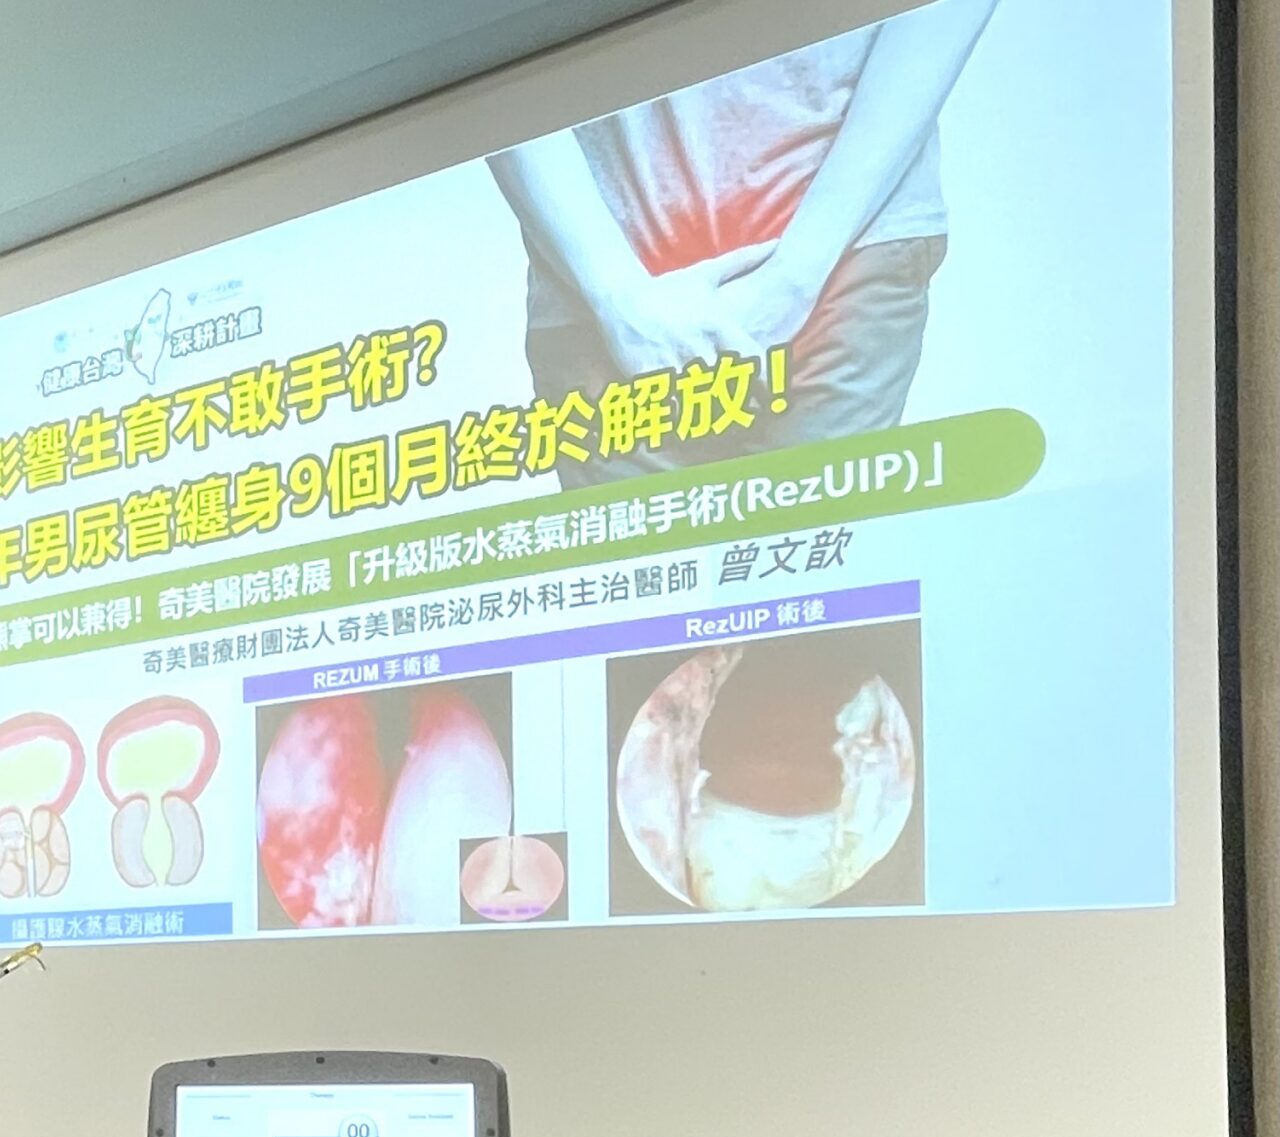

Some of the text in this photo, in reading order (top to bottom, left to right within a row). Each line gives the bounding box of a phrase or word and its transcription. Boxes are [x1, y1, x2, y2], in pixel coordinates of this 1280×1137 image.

[685, 600, 827, 639] RezUIP 術後
[312, 653, 442, 690] REZUM 手術後
